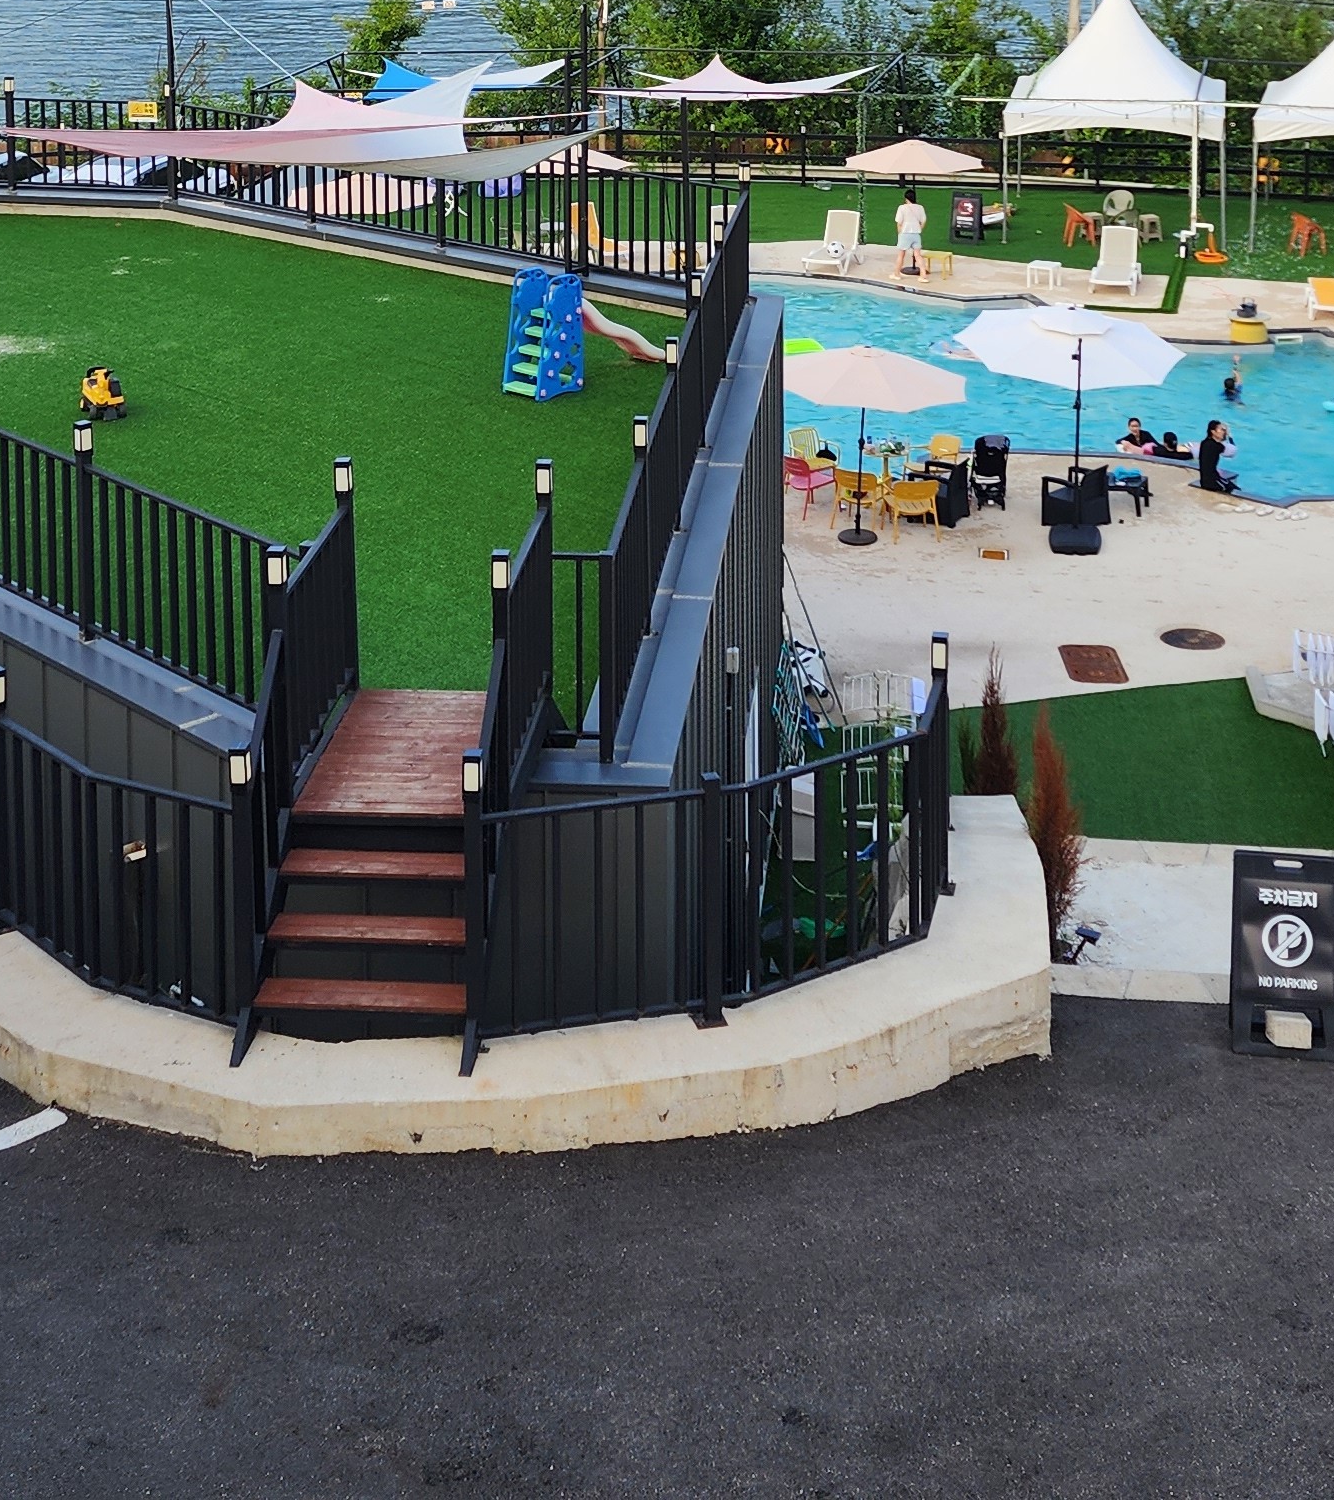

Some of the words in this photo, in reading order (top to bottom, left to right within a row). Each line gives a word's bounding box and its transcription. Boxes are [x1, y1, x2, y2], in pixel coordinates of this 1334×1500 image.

[1258, 887, 1318, 909] 주차금지
[1258, 975, 1273, 988] NO
[1274, 976, 1318, 991] PARKING
